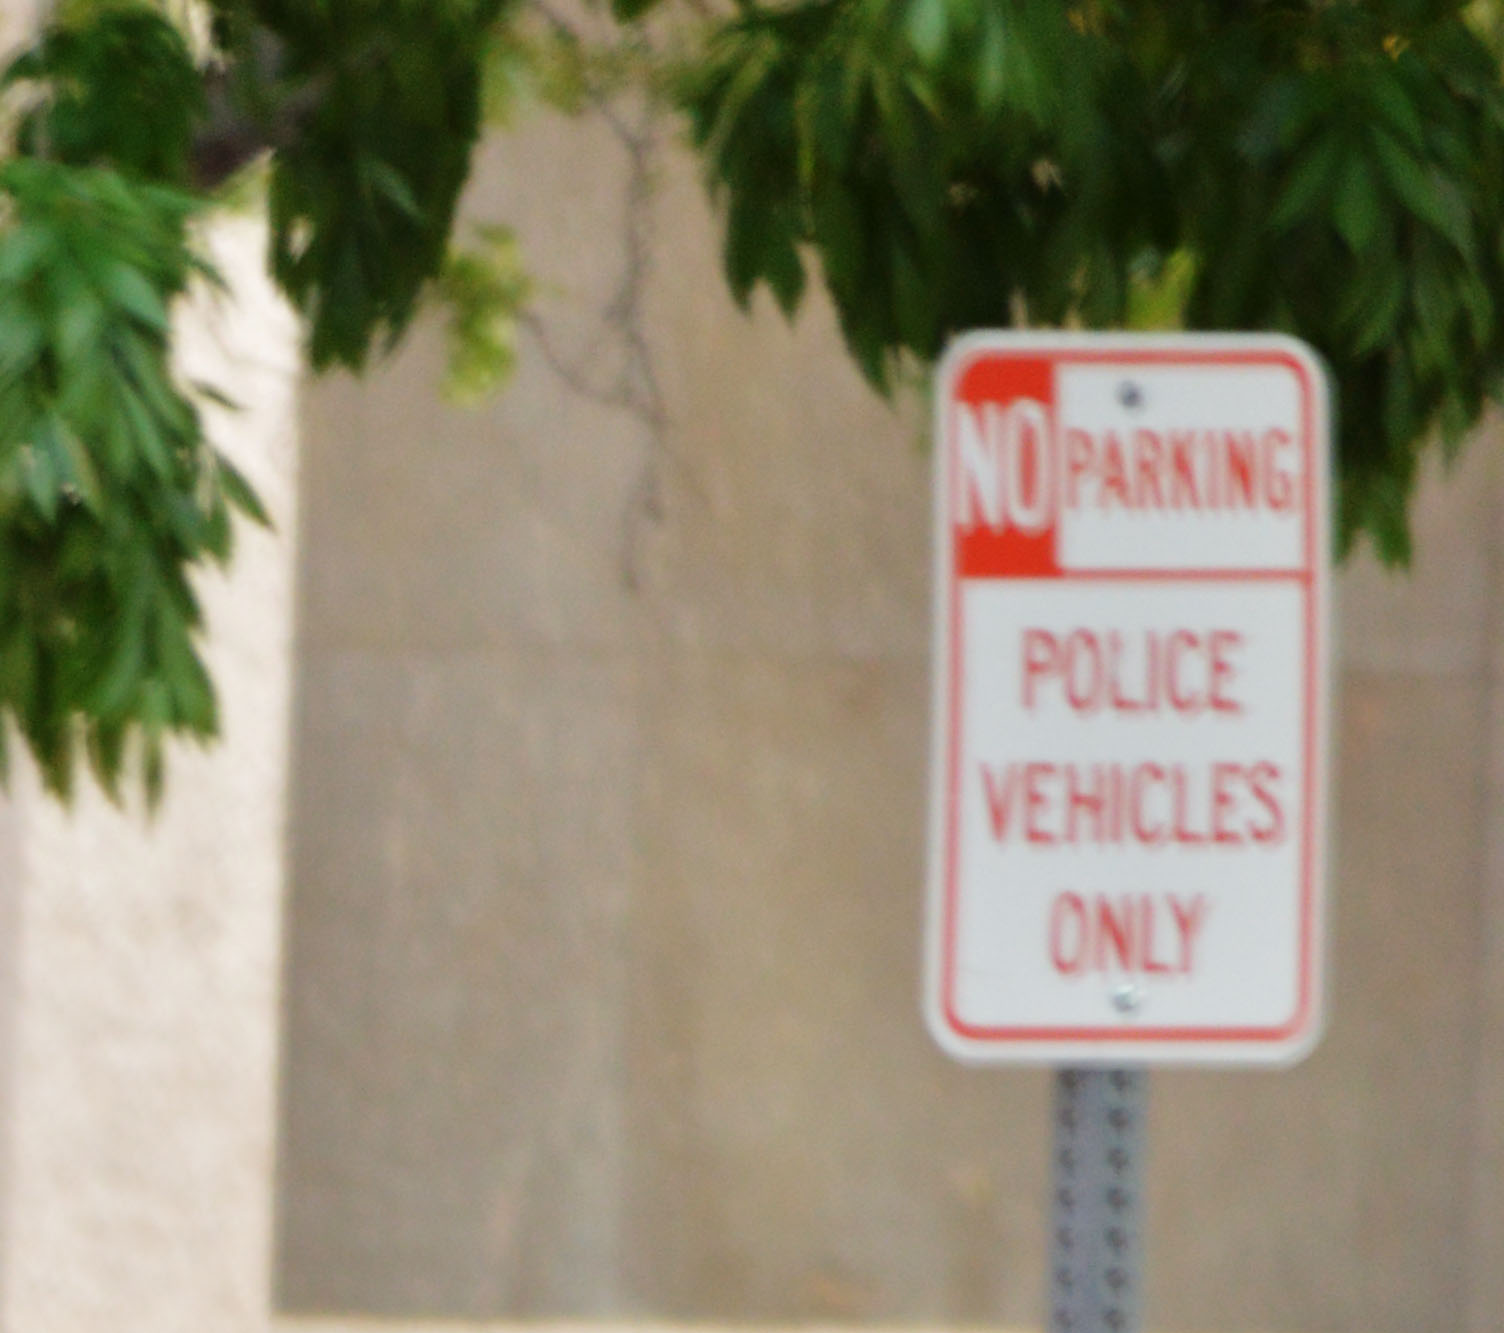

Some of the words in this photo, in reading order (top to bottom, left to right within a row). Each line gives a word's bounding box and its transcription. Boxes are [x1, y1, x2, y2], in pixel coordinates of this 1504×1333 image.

[955, 398, 1052, 536] NO
[1065, 428, 1297, 512] PARKING
[1020, 627, 1247, 716] POLICE
[980, 760, 1286, 846] VEHICLES
[1048, 890, 1212, 977] ONLY
